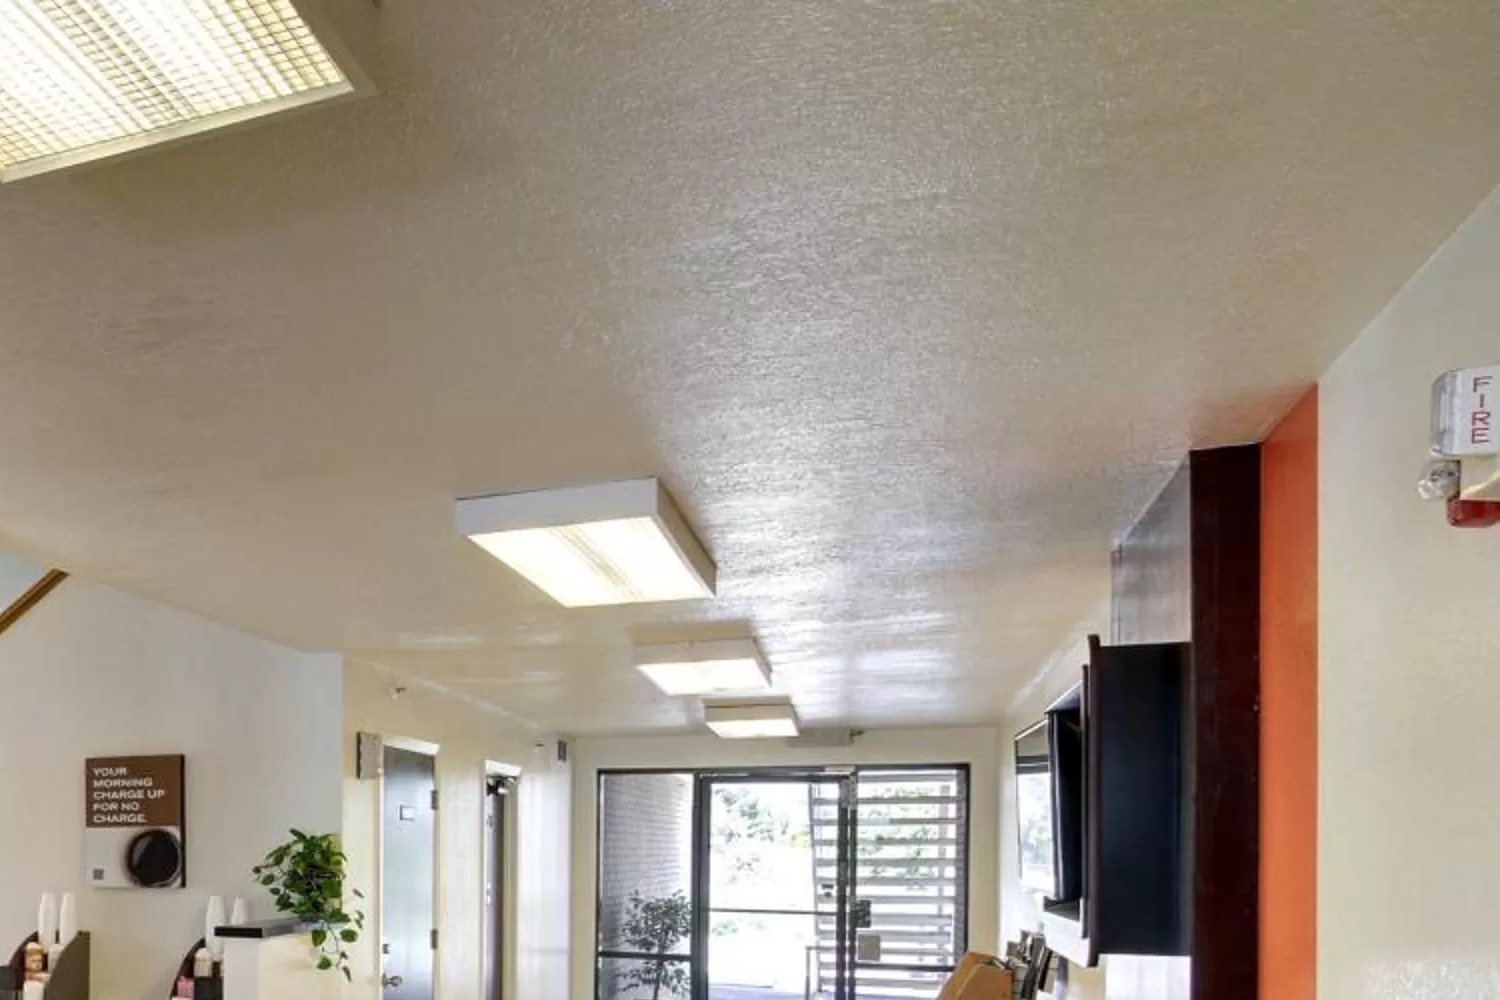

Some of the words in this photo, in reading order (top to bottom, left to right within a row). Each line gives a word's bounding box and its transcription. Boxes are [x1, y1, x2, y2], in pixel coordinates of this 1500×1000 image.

[1470, 374, 1493, 445] FIRE
[92, 766, 127, 777] YOUR
[92, 777, 153, 788] MORNING
[92, 789, 145, 800] CHARGE
[147, 788, 165, 799] UP
[92, 802, 118, 812] FOR
[121, 801, 140, 811] NO
